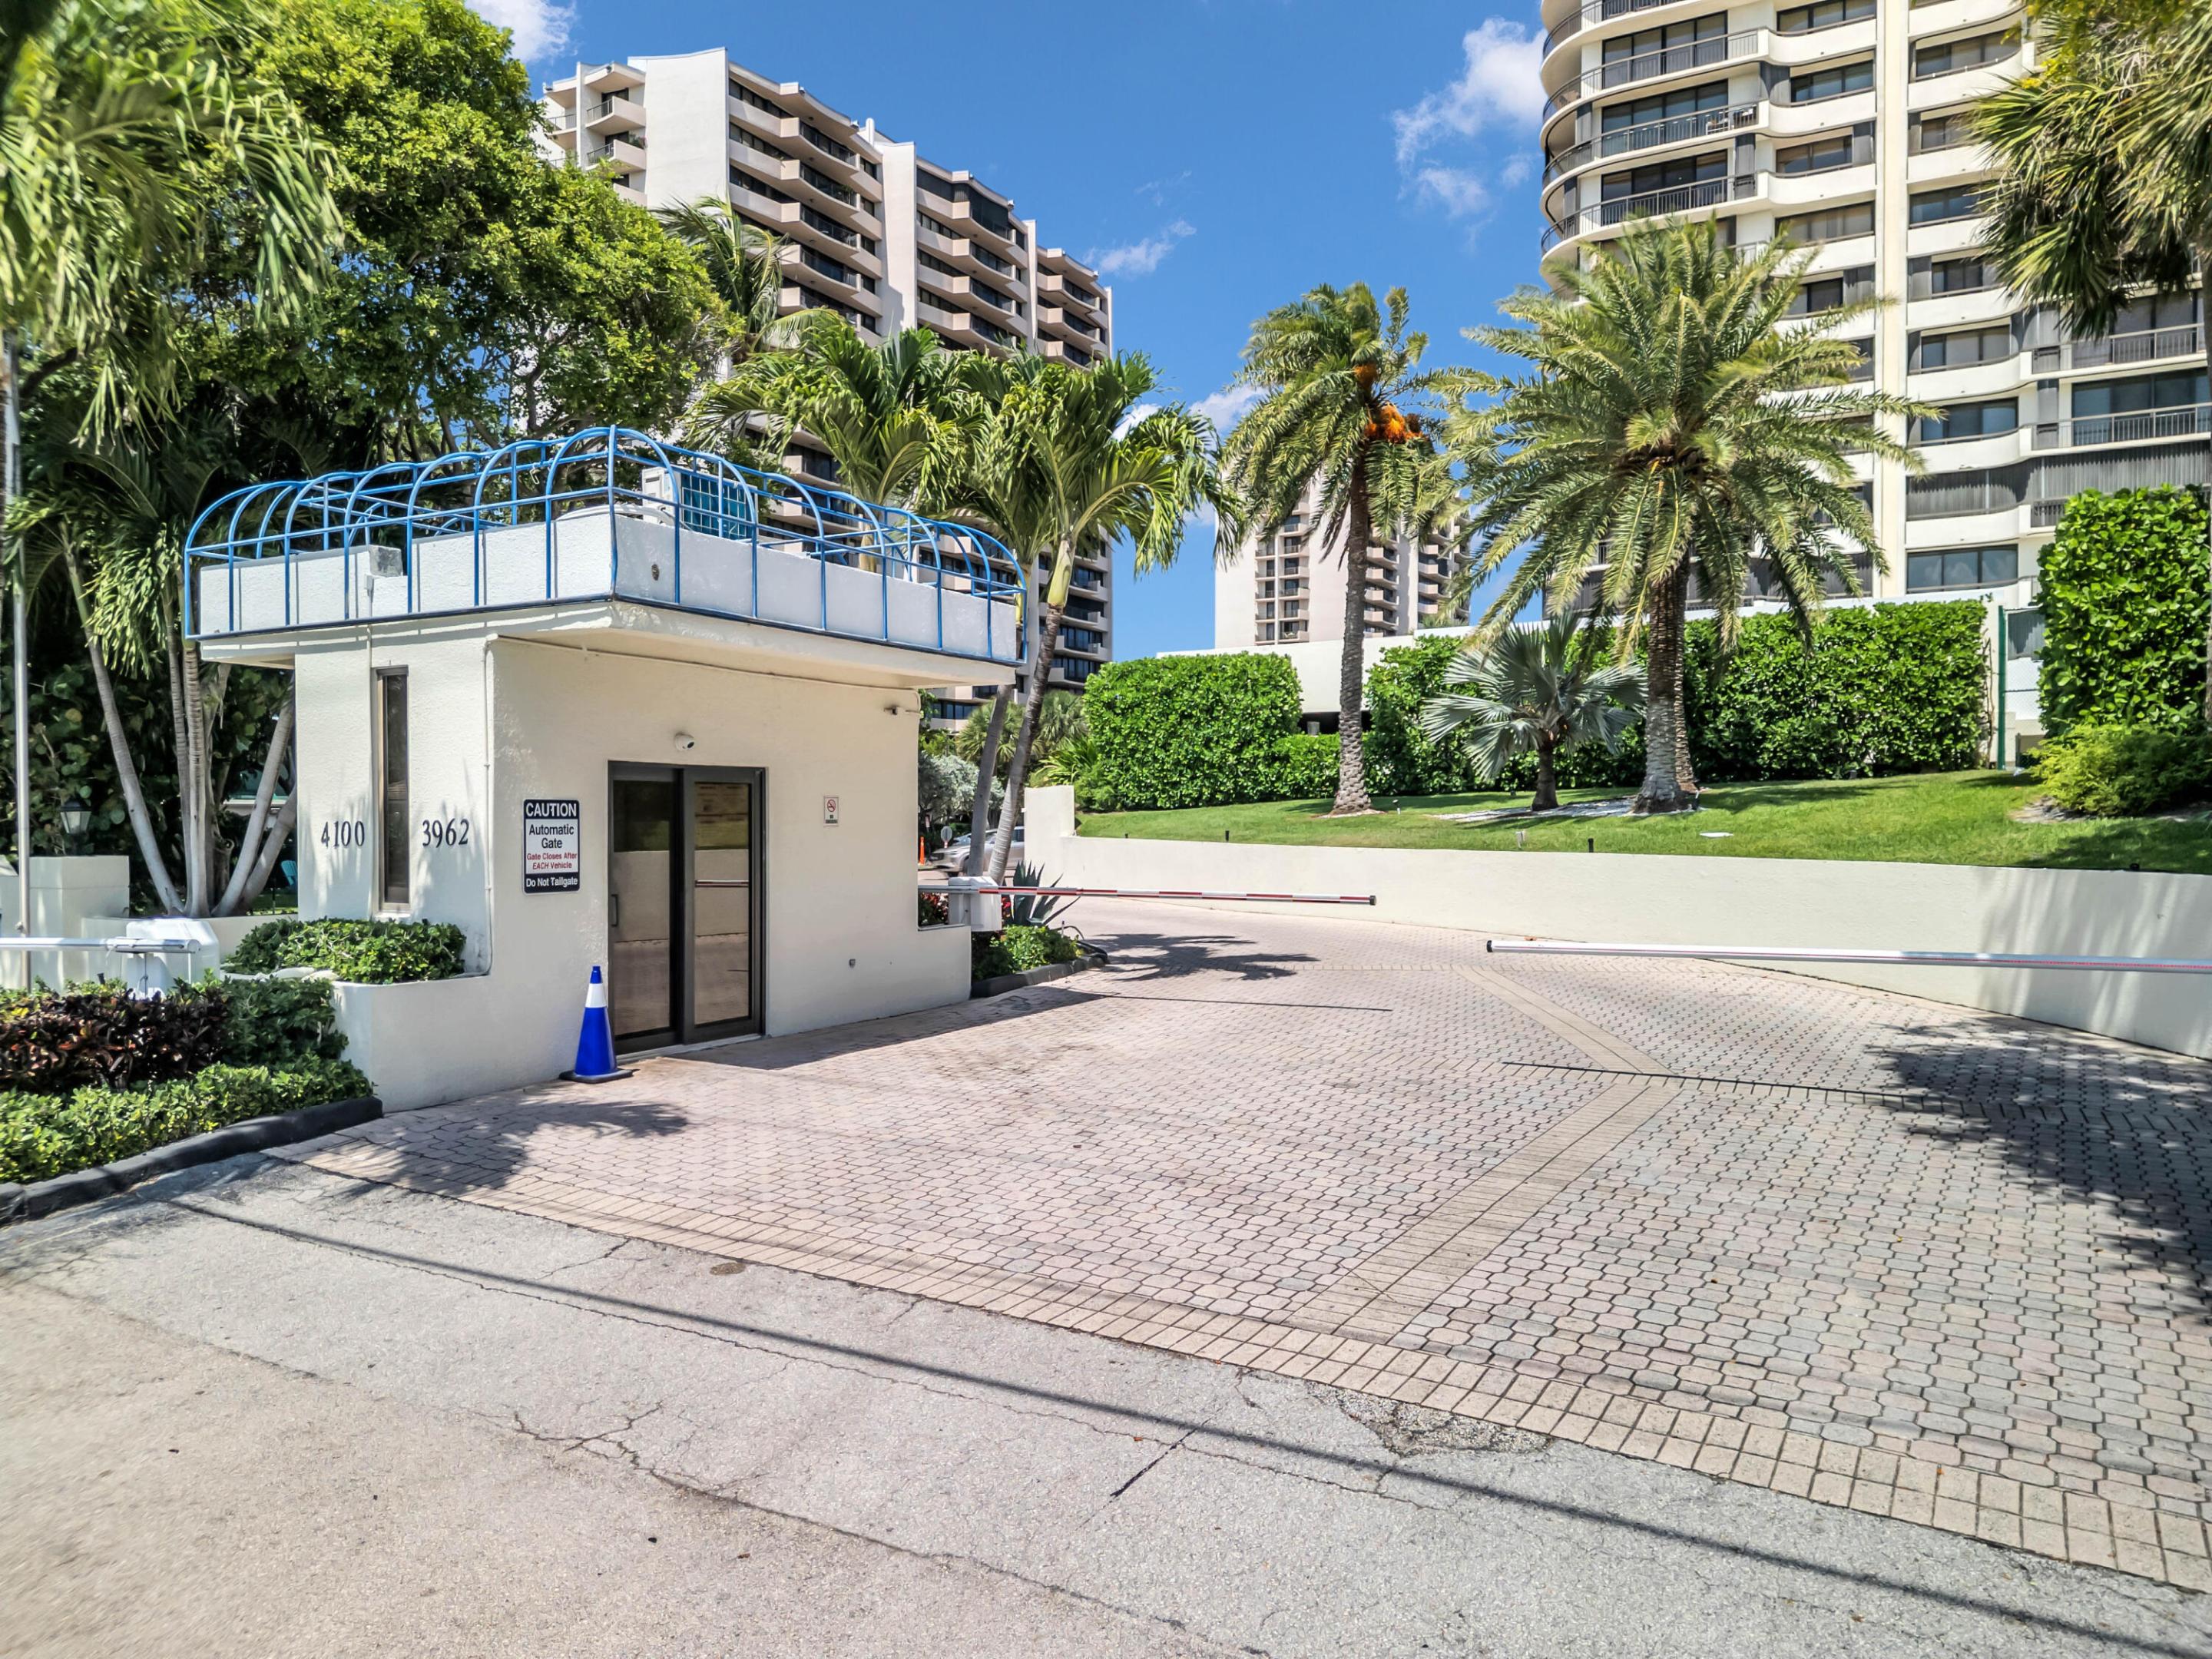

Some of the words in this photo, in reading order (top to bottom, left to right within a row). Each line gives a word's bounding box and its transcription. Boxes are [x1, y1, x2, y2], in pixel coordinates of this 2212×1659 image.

[525, 803, 577, 817] CAUTION
[321, 820, 366, 849] 4100
[422, 818, 470, 848] 3962
[528, 823, 575, 836] Automatic
[541, 837, 563, 849] Gate
[527, 853, 541, 861] Gate
[550, 861, 572, 869] Vehicle
[525, 878, 536, 888] Do
[538, 877, 550, 887] Not
[551, 876, 578, 888] Tailgate
